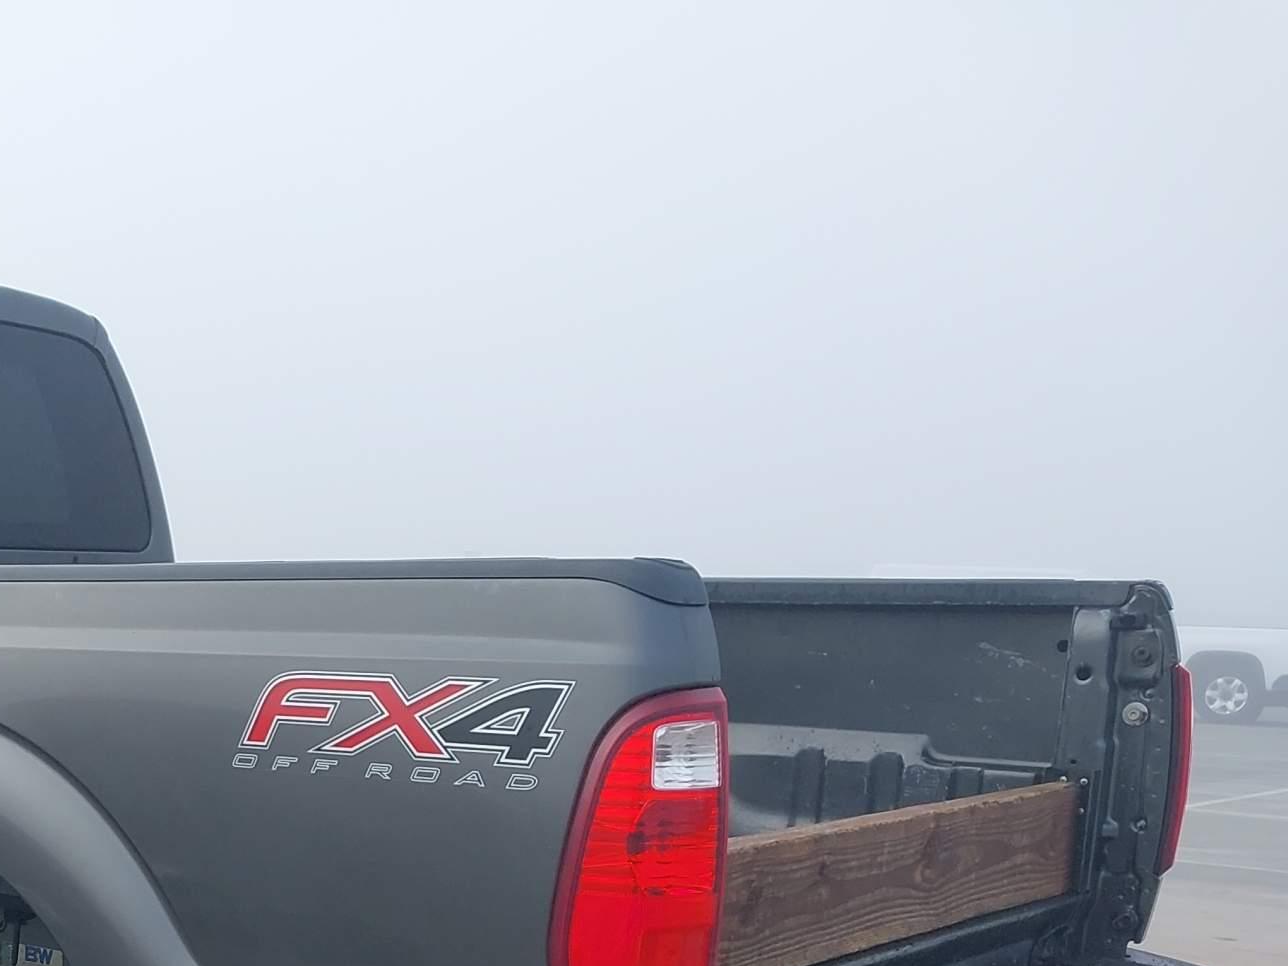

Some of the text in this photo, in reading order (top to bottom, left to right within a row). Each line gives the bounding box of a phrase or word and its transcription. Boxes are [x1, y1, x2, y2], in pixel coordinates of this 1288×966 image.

[238, 670, 576, 768] FX4
[232, 753, 539, 791] OFF ROAD
